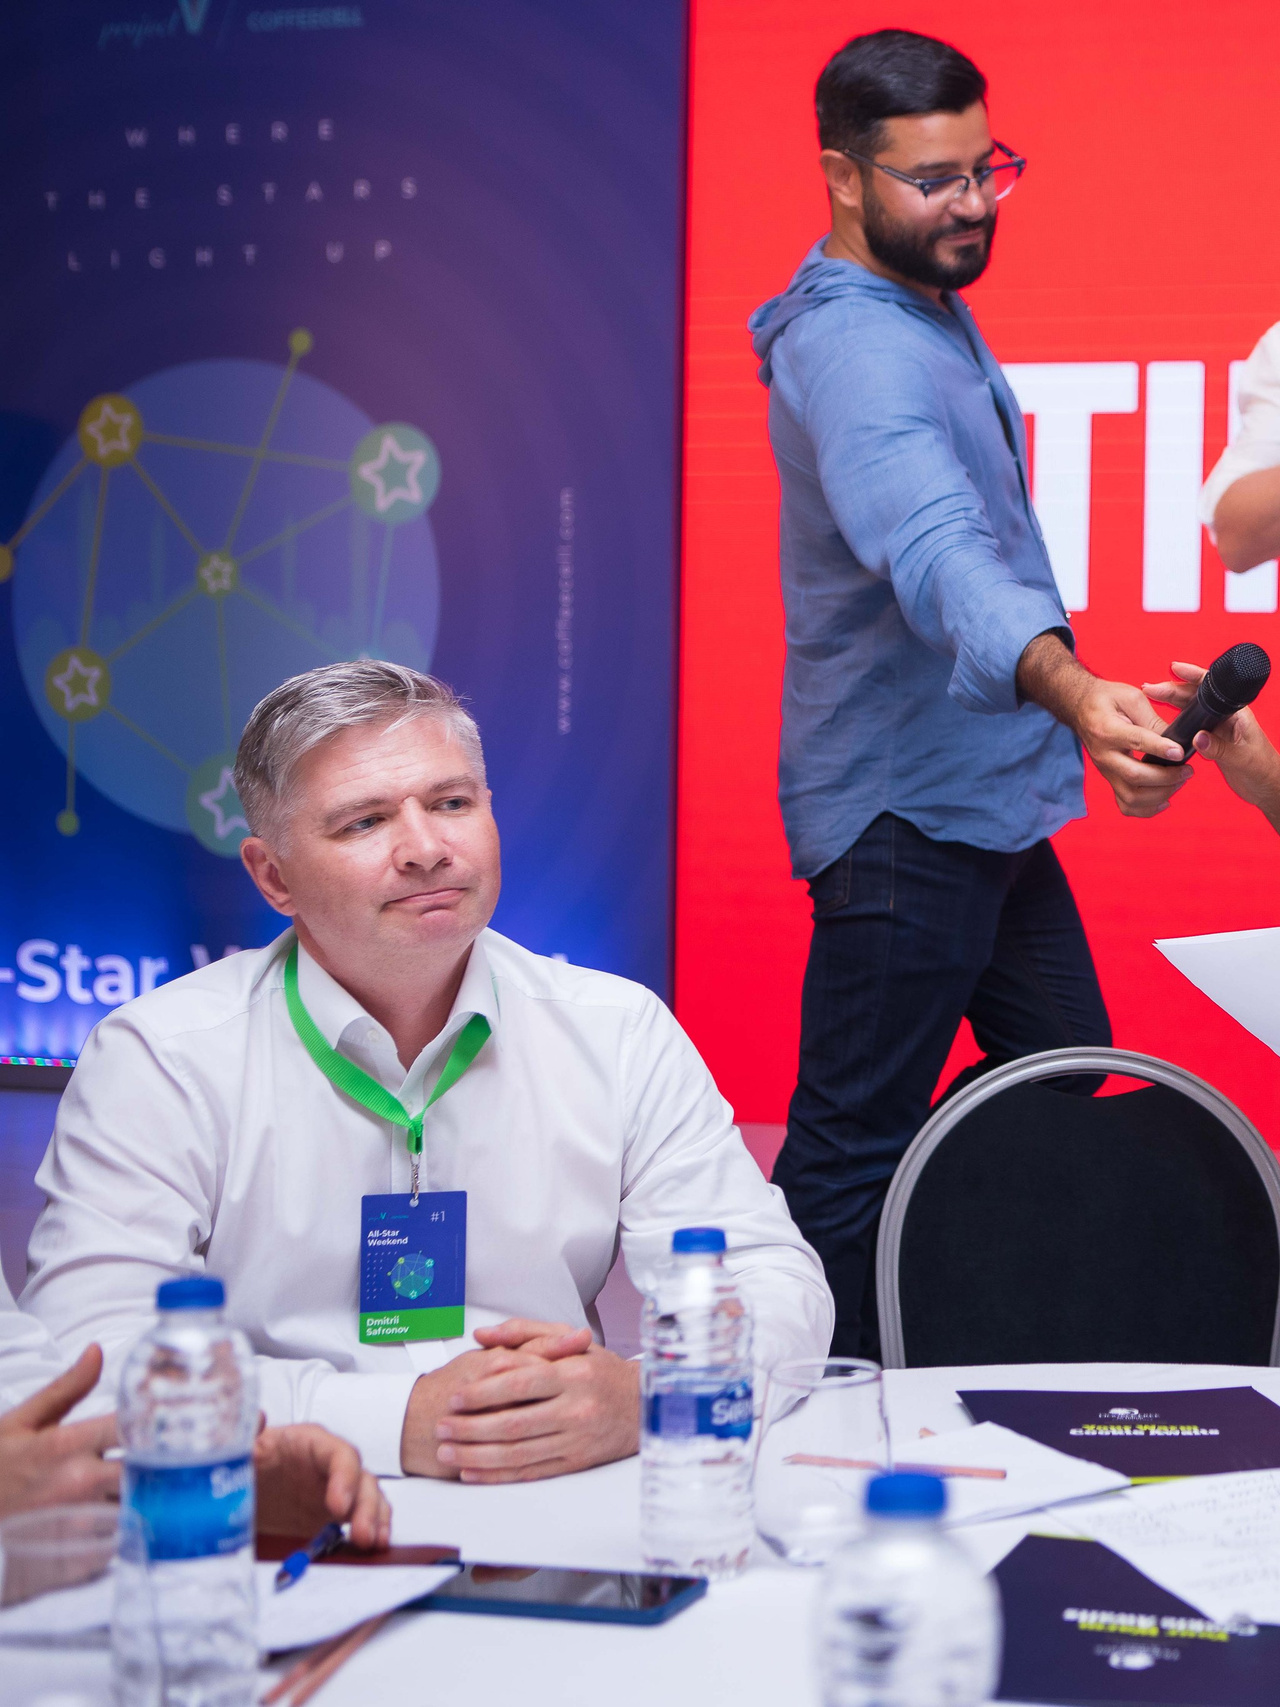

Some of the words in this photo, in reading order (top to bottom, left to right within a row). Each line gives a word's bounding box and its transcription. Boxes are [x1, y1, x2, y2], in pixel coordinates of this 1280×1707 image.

[125, 118, 335, 148] WHERE
[46, 187, 150, 211] THE
[216, 177, 418, 207] STARS
[67, 243, 258, 272] LIGHT
[326, 239, 393, 264] UP
[430, 1210, 446, 1223] #1
[367, 1229, 400, 1239] All-Star
[367, 1236, 409, 1247] Weekend
[366, 1315, 400, 1327] Dmitrii
[366, 1324, 410, 1337] Safronov
